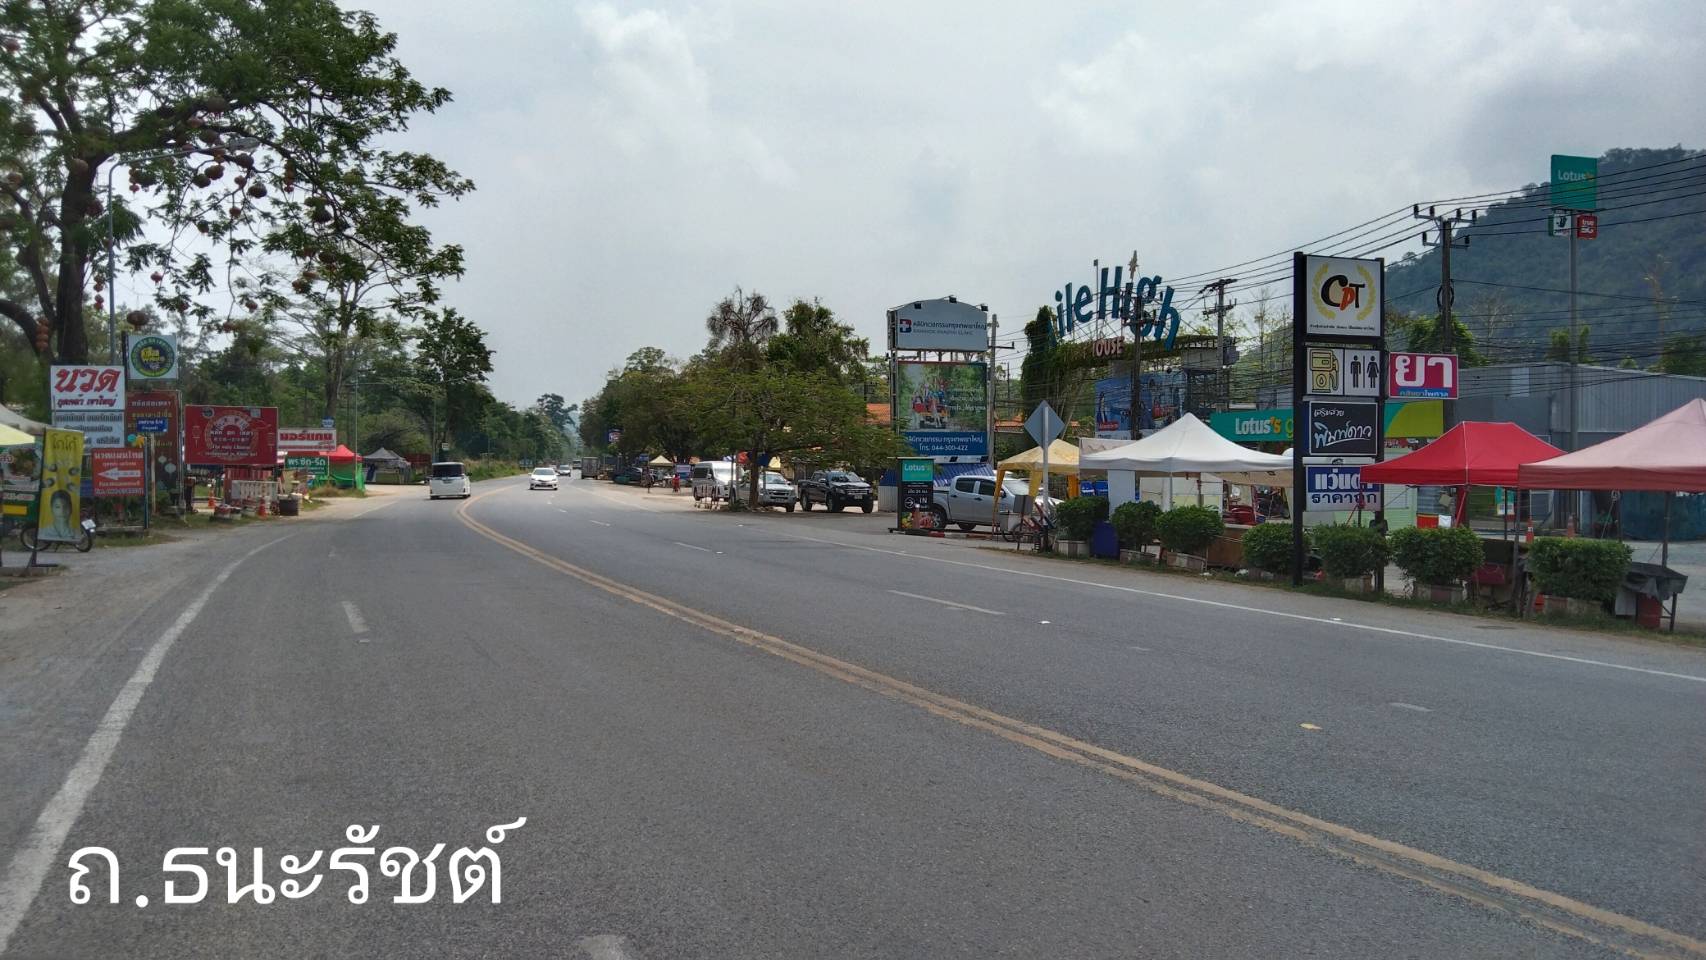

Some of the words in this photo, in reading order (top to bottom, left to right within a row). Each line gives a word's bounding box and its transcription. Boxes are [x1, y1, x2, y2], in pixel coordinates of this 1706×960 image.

[54, 368, 122, 393] นวด
[1395, 355, 1453, 388] ยา
[1235, 416, 1282, 435] Lotus's
[1313, 420, 1373, 449] พิมพ์ดาว
